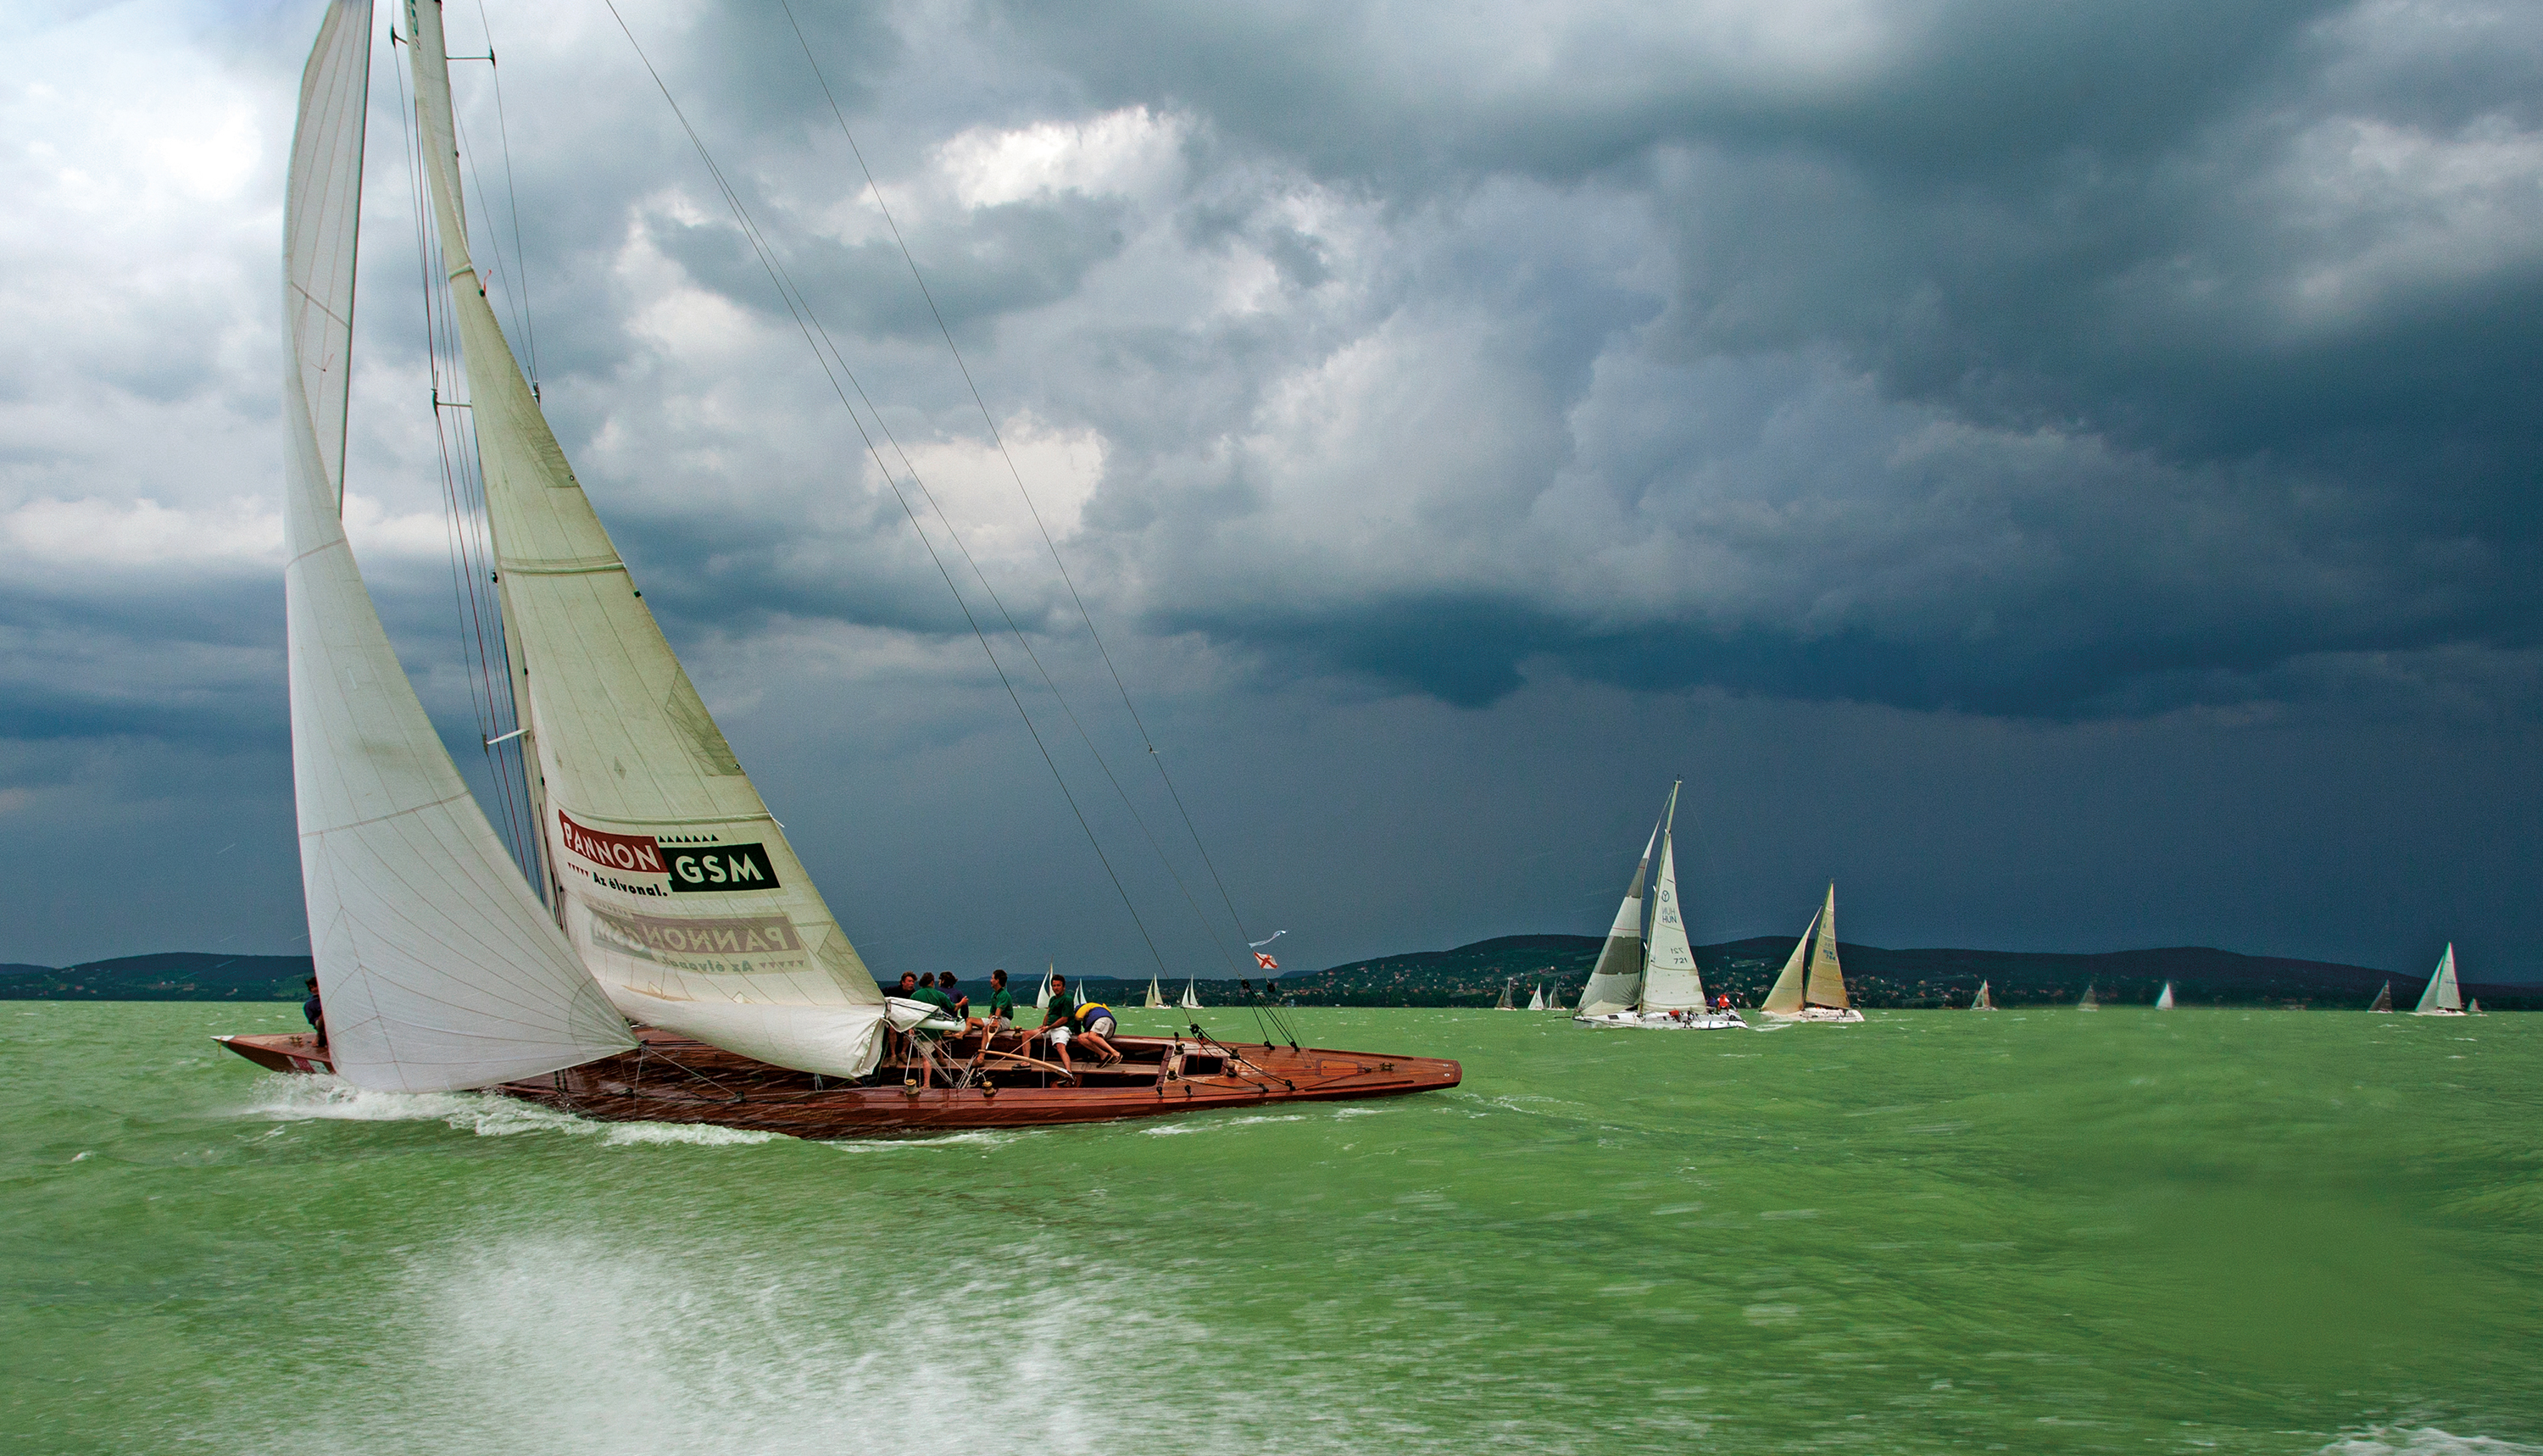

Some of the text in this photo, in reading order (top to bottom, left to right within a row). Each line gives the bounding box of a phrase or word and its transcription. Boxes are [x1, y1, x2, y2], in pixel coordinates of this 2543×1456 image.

[564, 821, 765, 883] PANNON GSM
[593, 871, 669, 897] Az élvonal.
[1662, 915, 1678, 924] HUN
